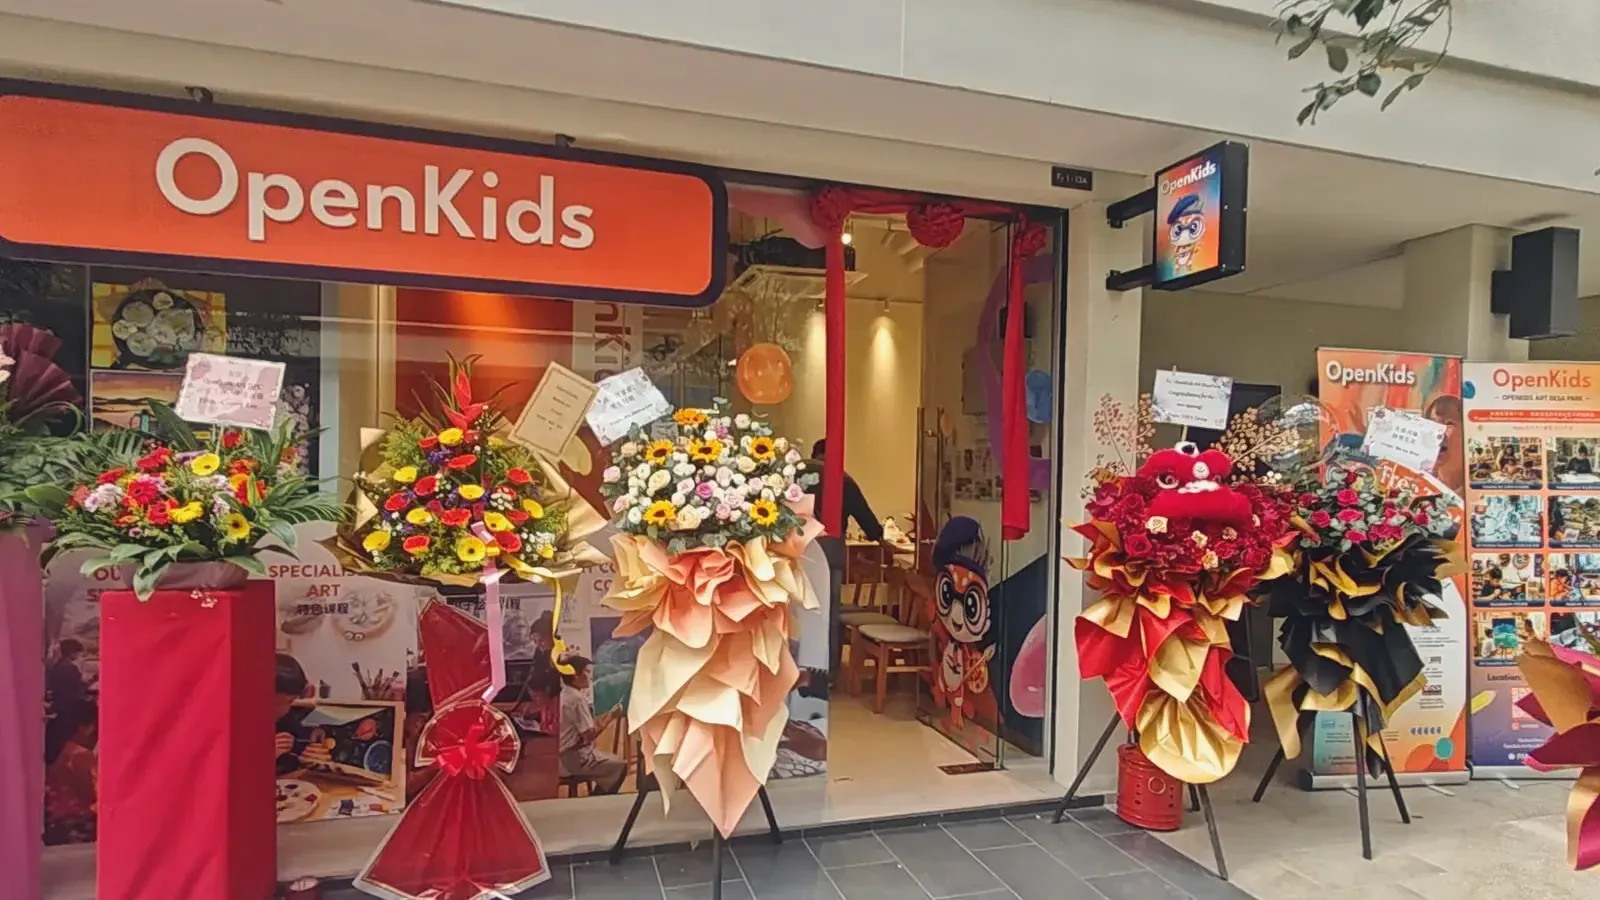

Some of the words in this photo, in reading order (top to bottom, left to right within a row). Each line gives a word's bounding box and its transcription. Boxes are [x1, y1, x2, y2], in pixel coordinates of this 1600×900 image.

[1160, 161, 1217, 196] OpenKids
[155, 136, 596, 250] OpenKids
[1325, 360, 1417, 388] OpenKids
[1493, 368, 1592, 391] OpenKids
[306, 584, 341, 597] ART
[295, 602, 349, 616] 特色课程
